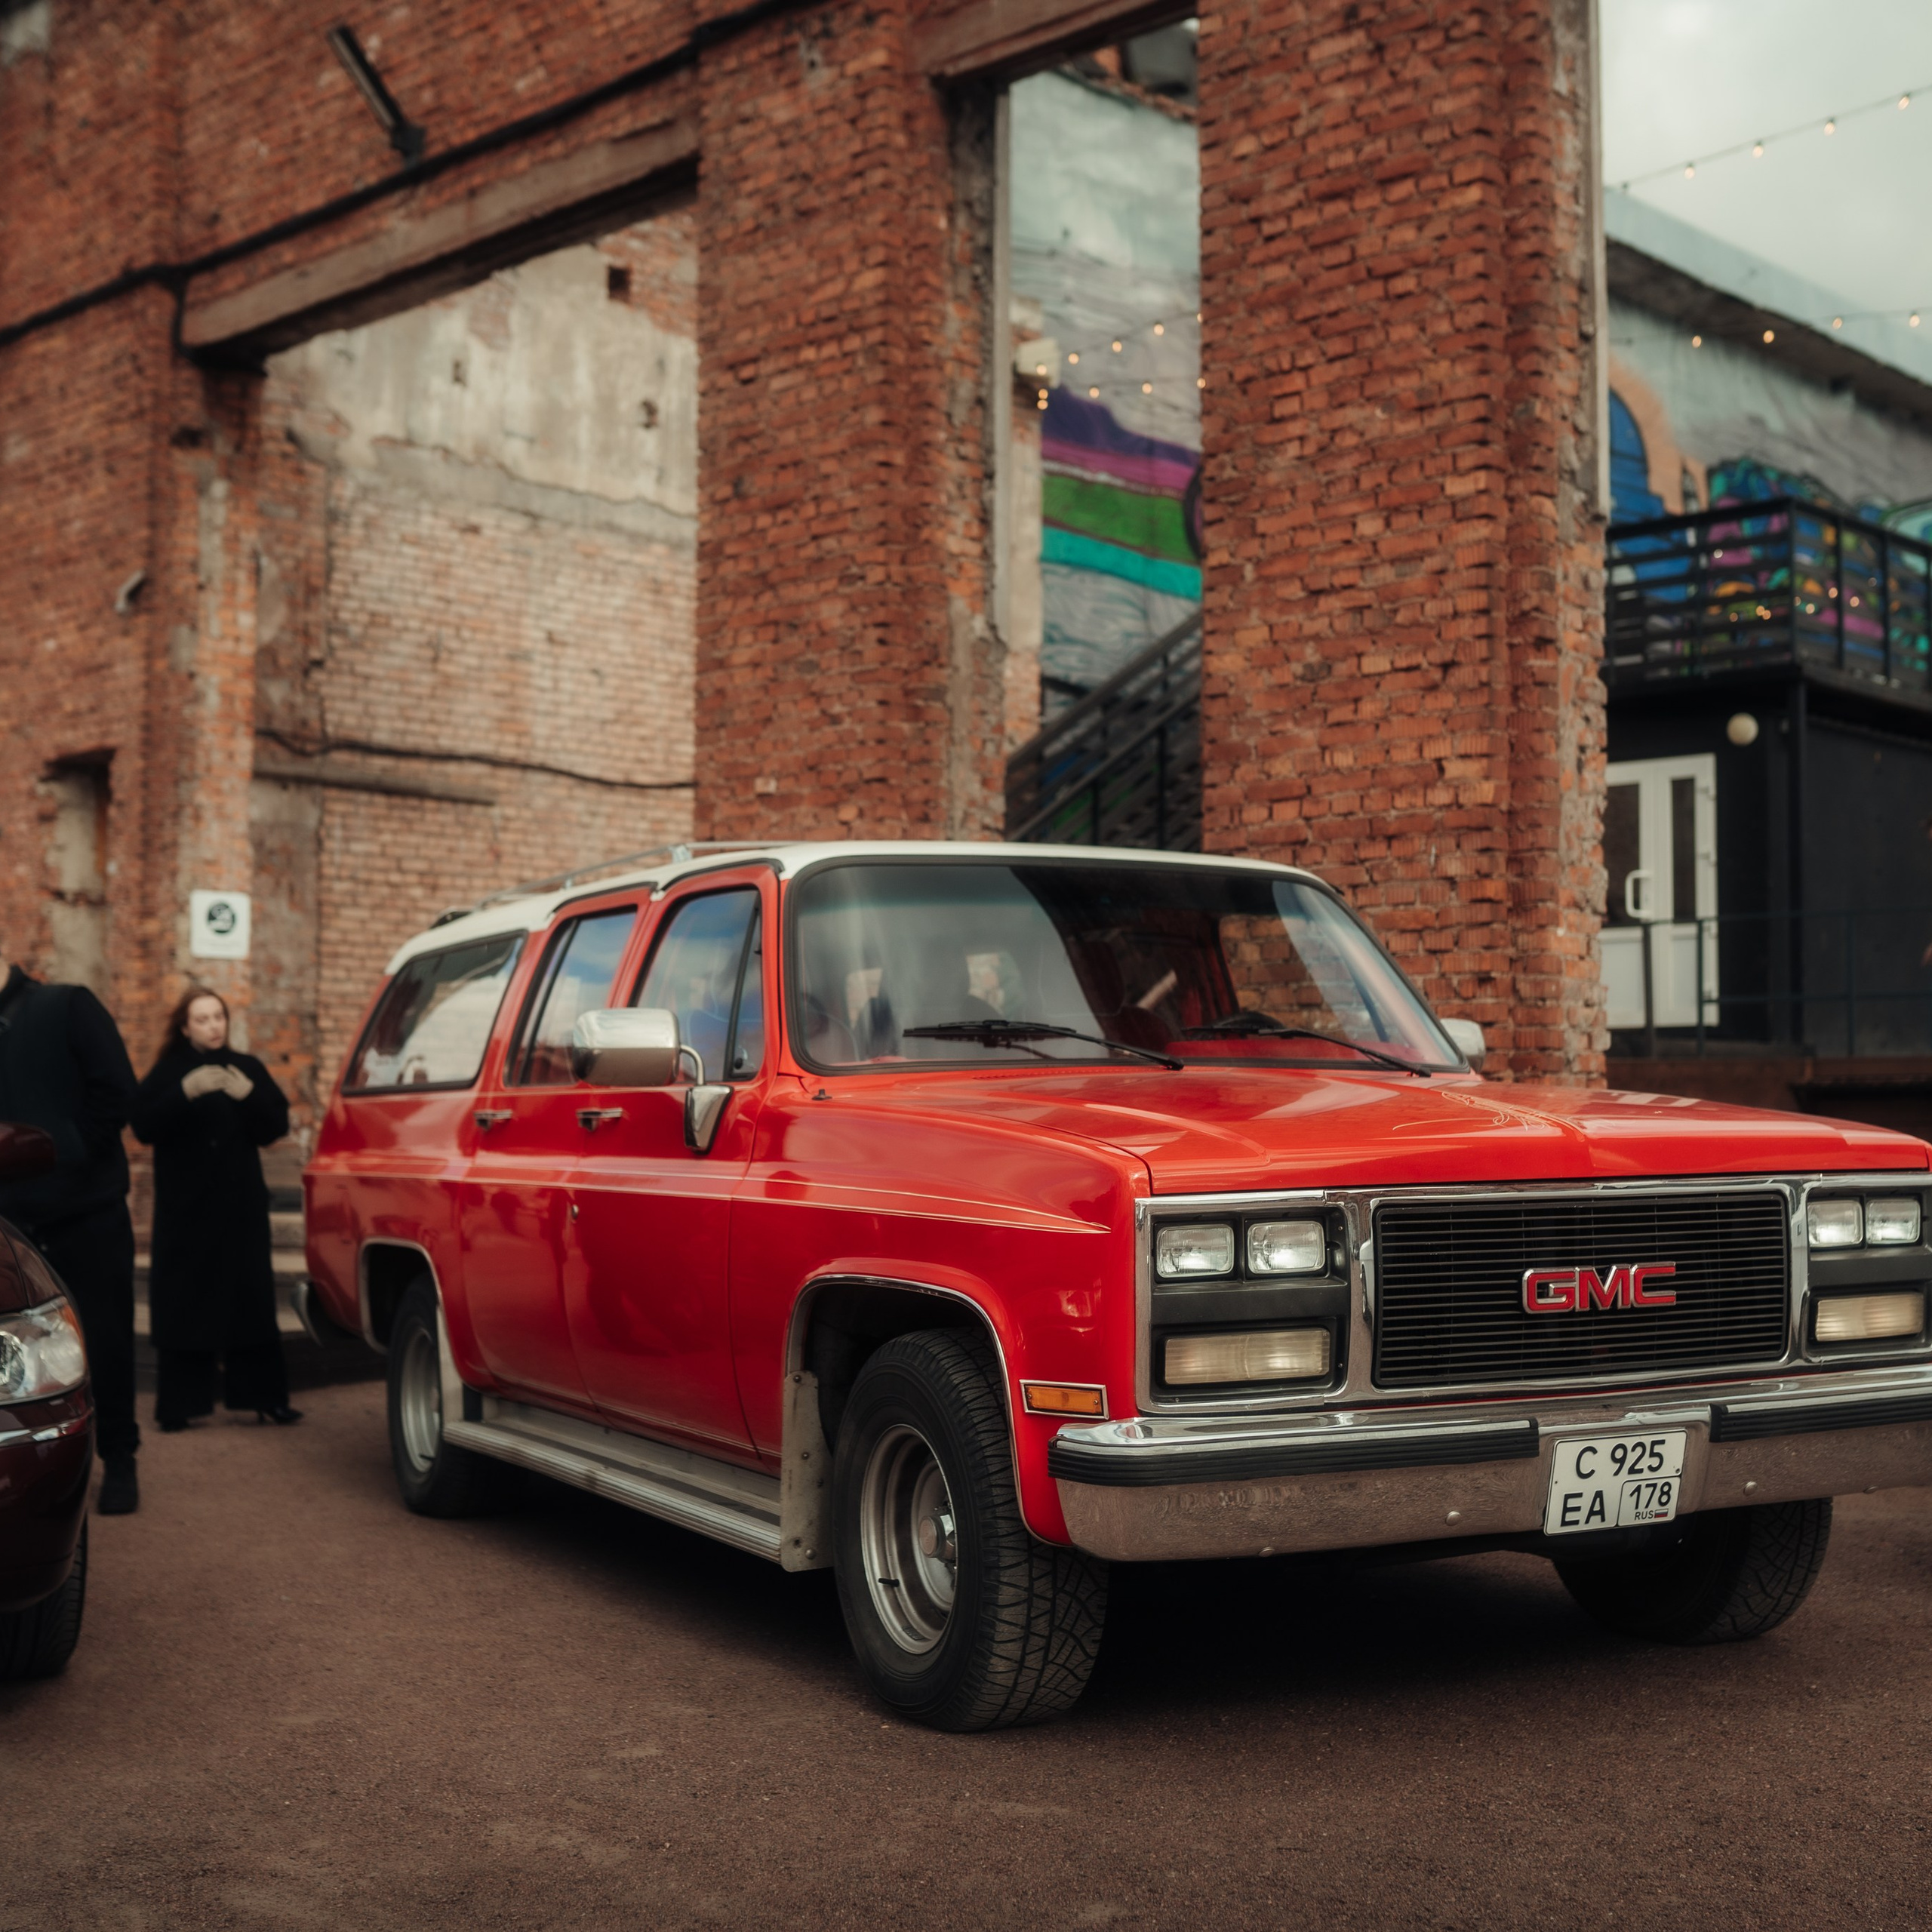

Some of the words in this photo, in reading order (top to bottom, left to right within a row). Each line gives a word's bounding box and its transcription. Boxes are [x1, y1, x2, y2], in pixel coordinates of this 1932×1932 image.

[1521, 1262, 1676, 1314] GMC
[1611, 1439, 1666, 1476] 925
[1560, 1490, 1606, 1527] EA
[1629, 1481, 1672, 1510] 178
[1634, 1510, 1654, 1521] RUS
